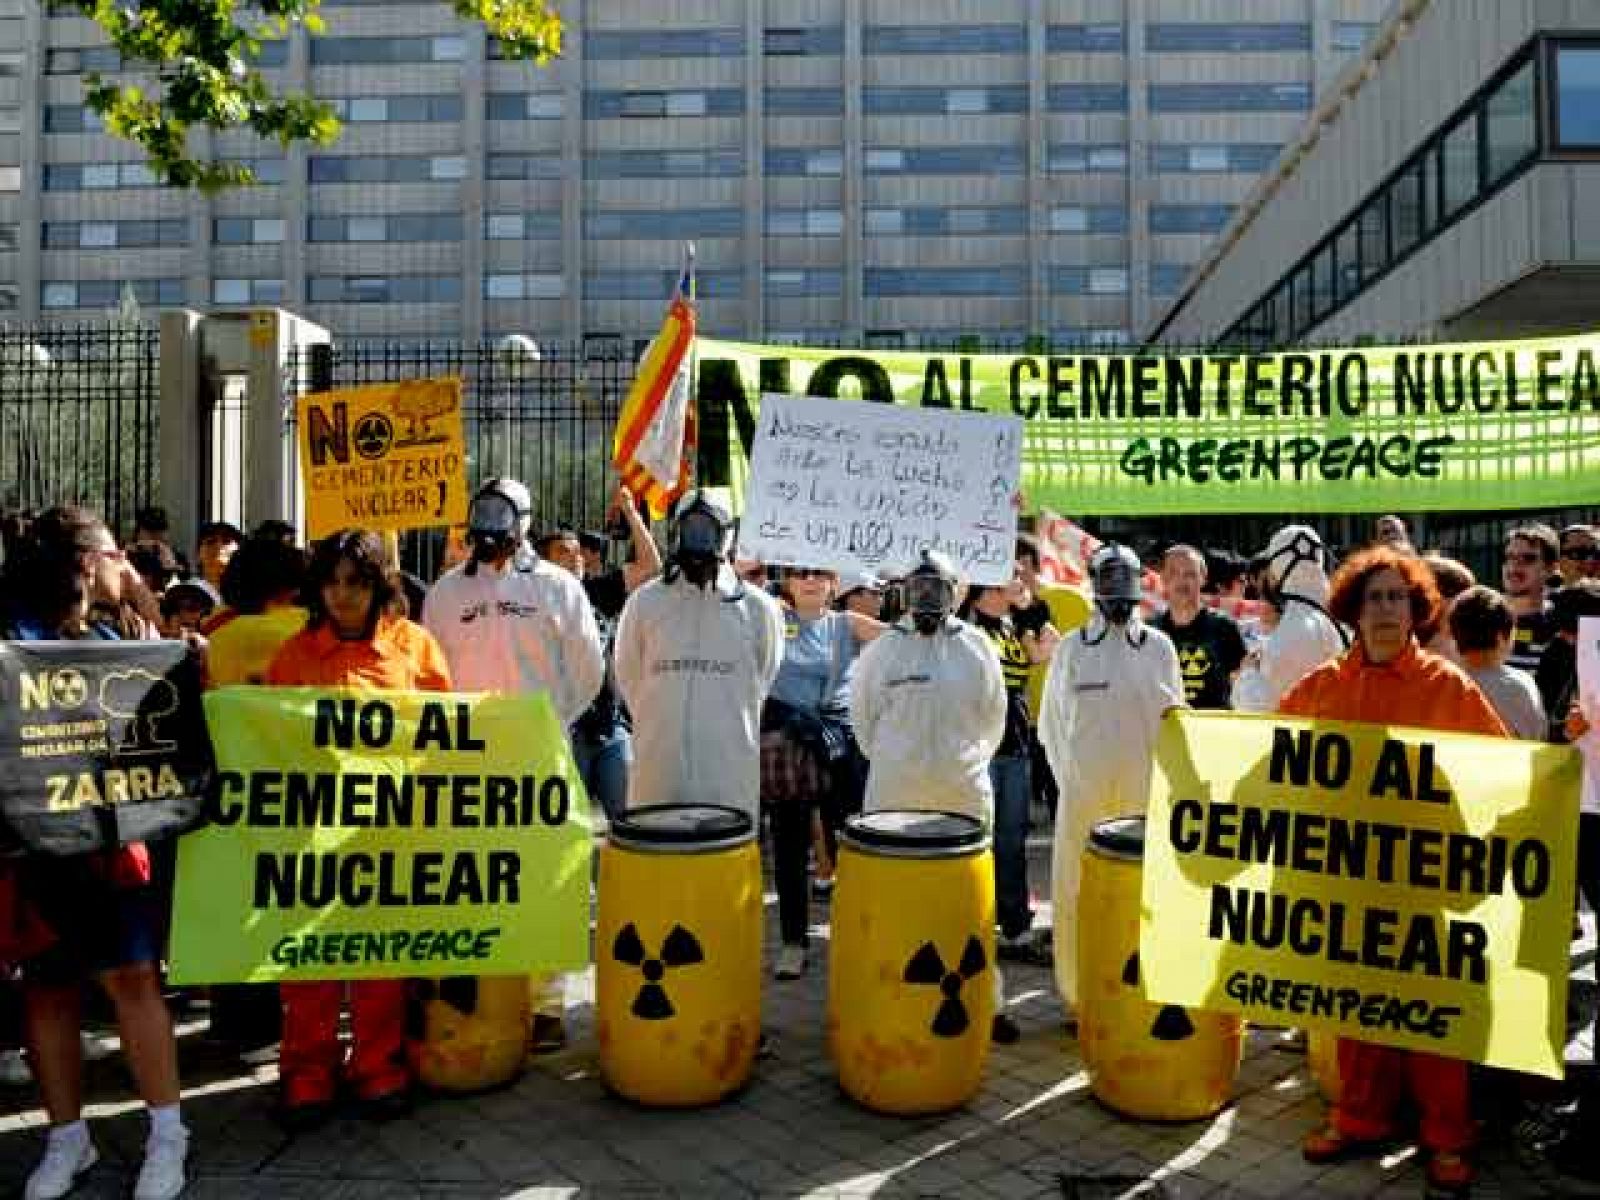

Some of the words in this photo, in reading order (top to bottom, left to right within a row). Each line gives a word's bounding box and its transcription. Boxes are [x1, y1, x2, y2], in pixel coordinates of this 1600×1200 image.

[920, 357, 988, 411] AL
[1009, 353, 1368, 419] CEMENTERIO
[1119, 435, 1454, 484] GREENPEACE
[314, 699, 393, 749] NO
[413, 701, 485, 751] AL
[46, 764, 183, 811] ZARRA
[1269, 727, 1351, 789] NO
[1369, 740, 1450, 803] AL
[213, 772, 568, 828] CEMENTERIO
[1169, 799, 1551, 899] CEMENTERIO
[254, 850, 521, 909] NUCLEAR
[271, 927, 500, 968] GREENPEACE
[1209, 884, 1488, 984] NUCLEAR
[1226, 971, 1461, 1038] GREENPEACE
